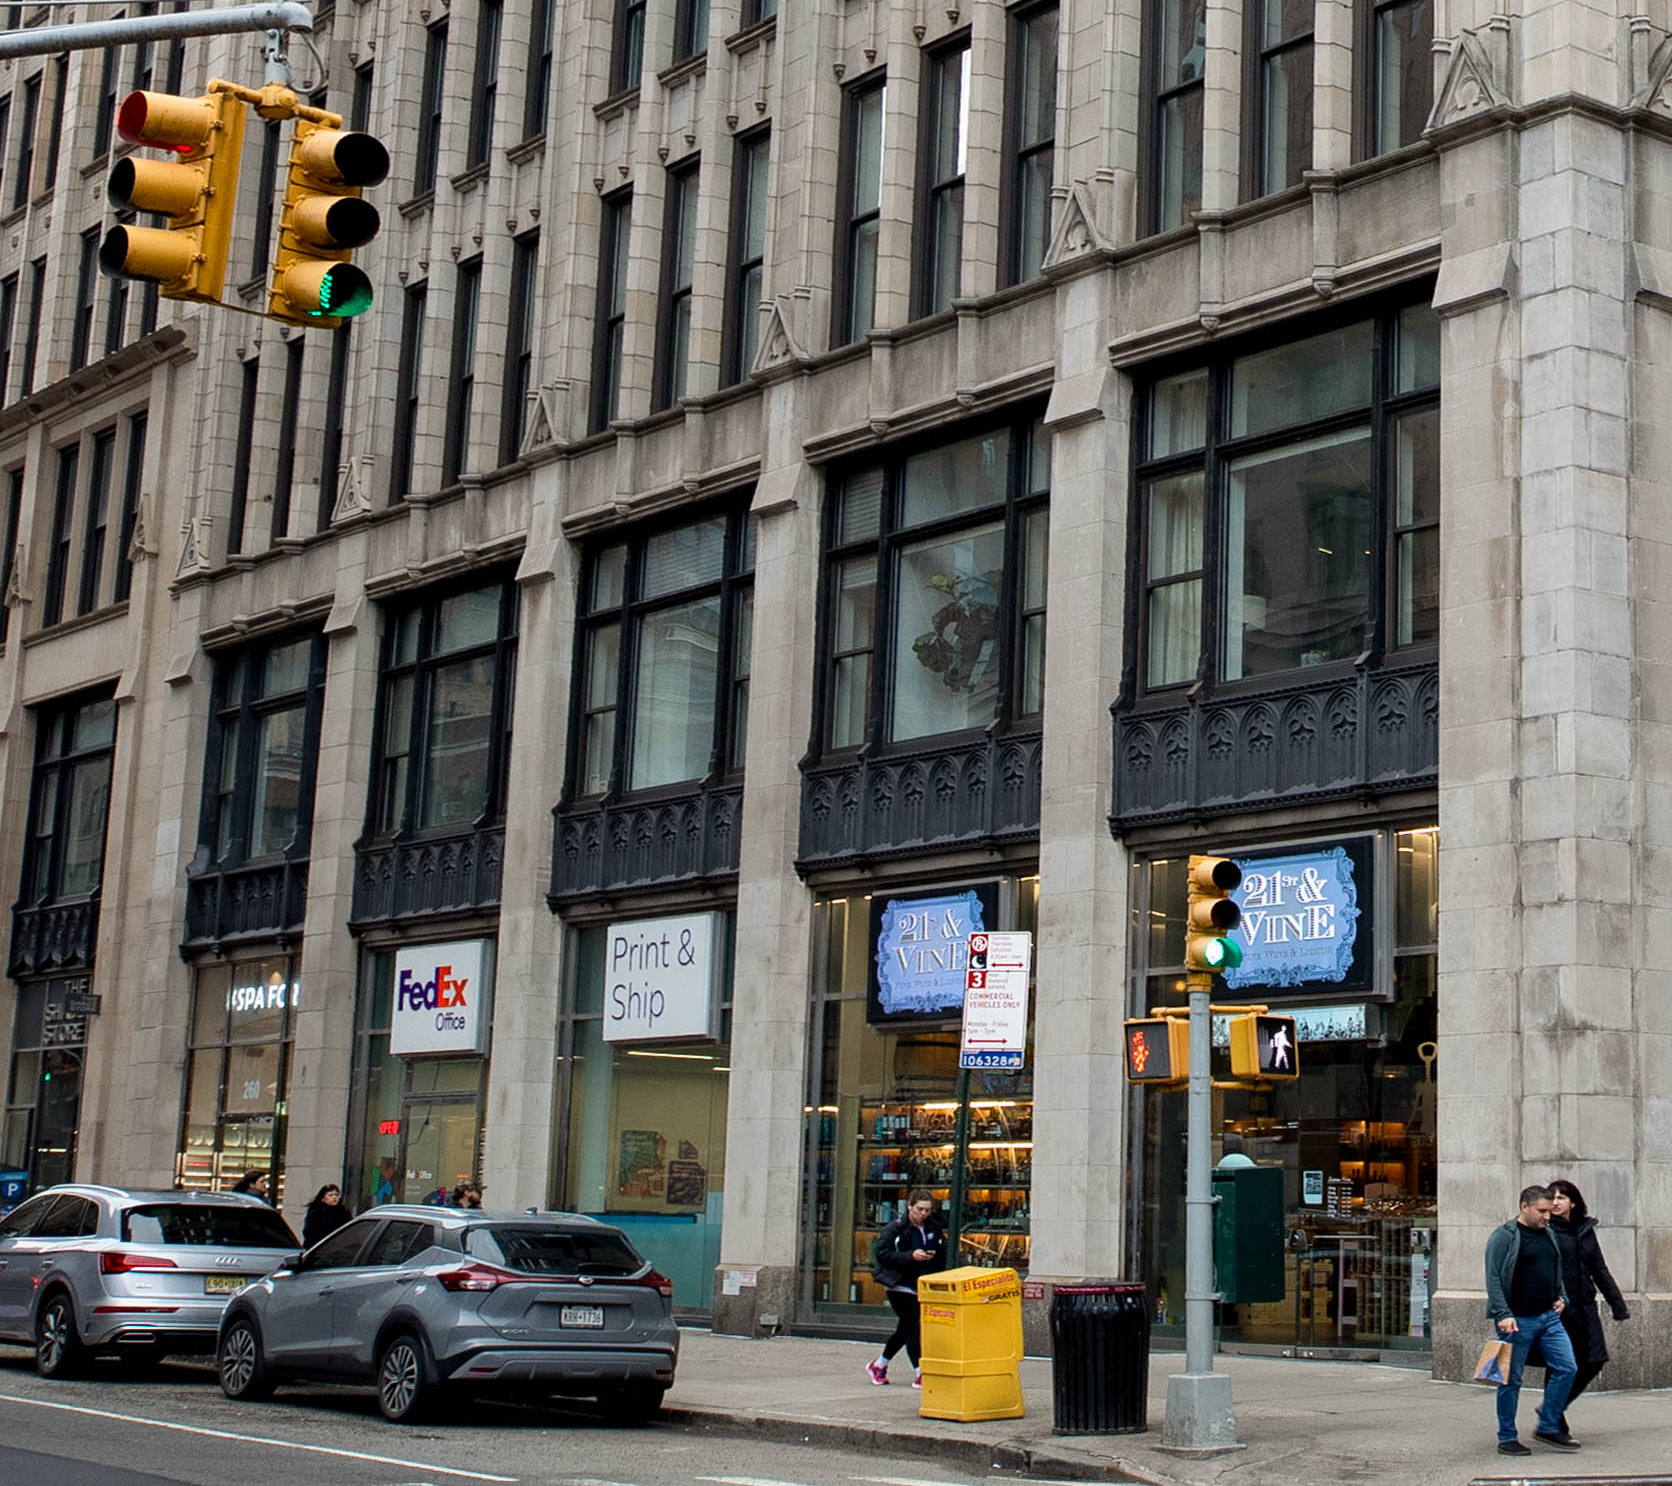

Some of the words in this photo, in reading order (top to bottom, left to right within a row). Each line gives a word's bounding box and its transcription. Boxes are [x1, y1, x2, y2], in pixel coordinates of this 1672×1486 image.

[1296, 868, 1328, 904] &
[940, 908, 964, 940] &
[1241, 904, 1335, 947] VINE
[613, 932, 670, 973] Print
[677, 928, 695, 967] &
[893, 940, 969, 975] VINE
[397, 965, 469, 1011] FedEx
[971, 972, 983, 988] 3
[611, 981, 665, 1029] Ship
[969, 993, 1014, 1001] COMMERCIAL
[969, 1001, 1001, 1009] VEHICLES
[1002, 1001, 1021, 1009] ONLY
[435, 1012, 466, 1032] Office
[962, 1055, 1006, 1067] 106328
[7, 1182, 19, 1197] P
[963, 1282, 973, 1292] El
[973, 1272, 1015, 1291] Especialito
